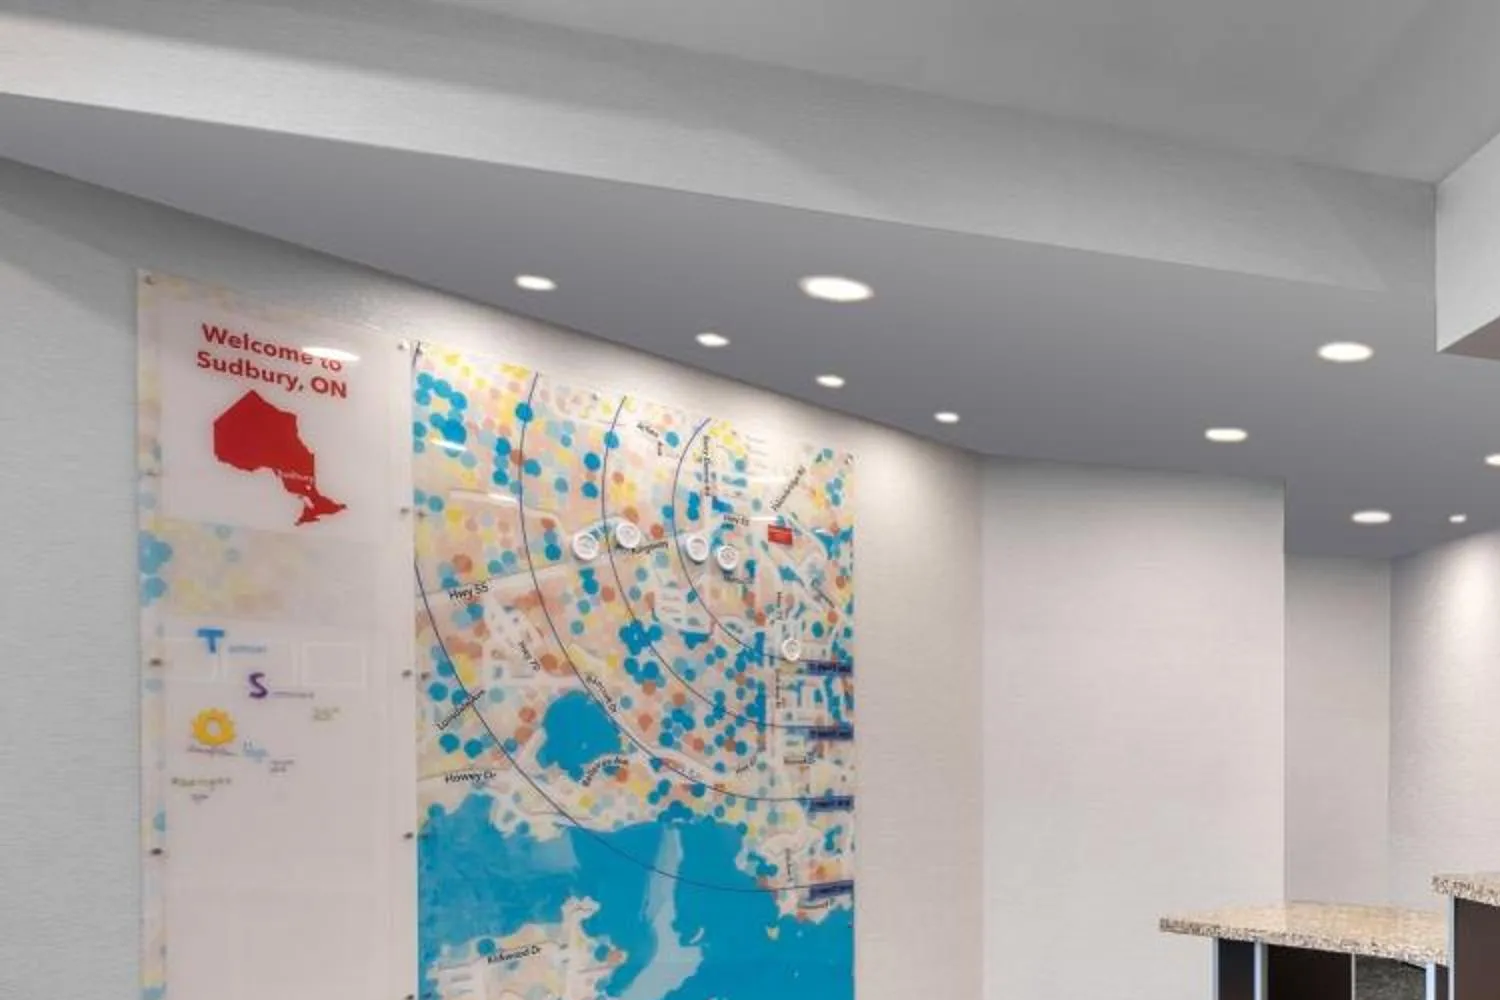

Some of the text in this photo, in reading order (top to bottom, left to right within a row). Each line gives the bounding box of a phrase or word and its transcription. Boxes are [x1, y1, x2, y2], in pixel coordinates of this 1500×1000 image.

[202, 323, 342, 372] Welcome to
[197, 351, 347, 399] Sudbury, ON
